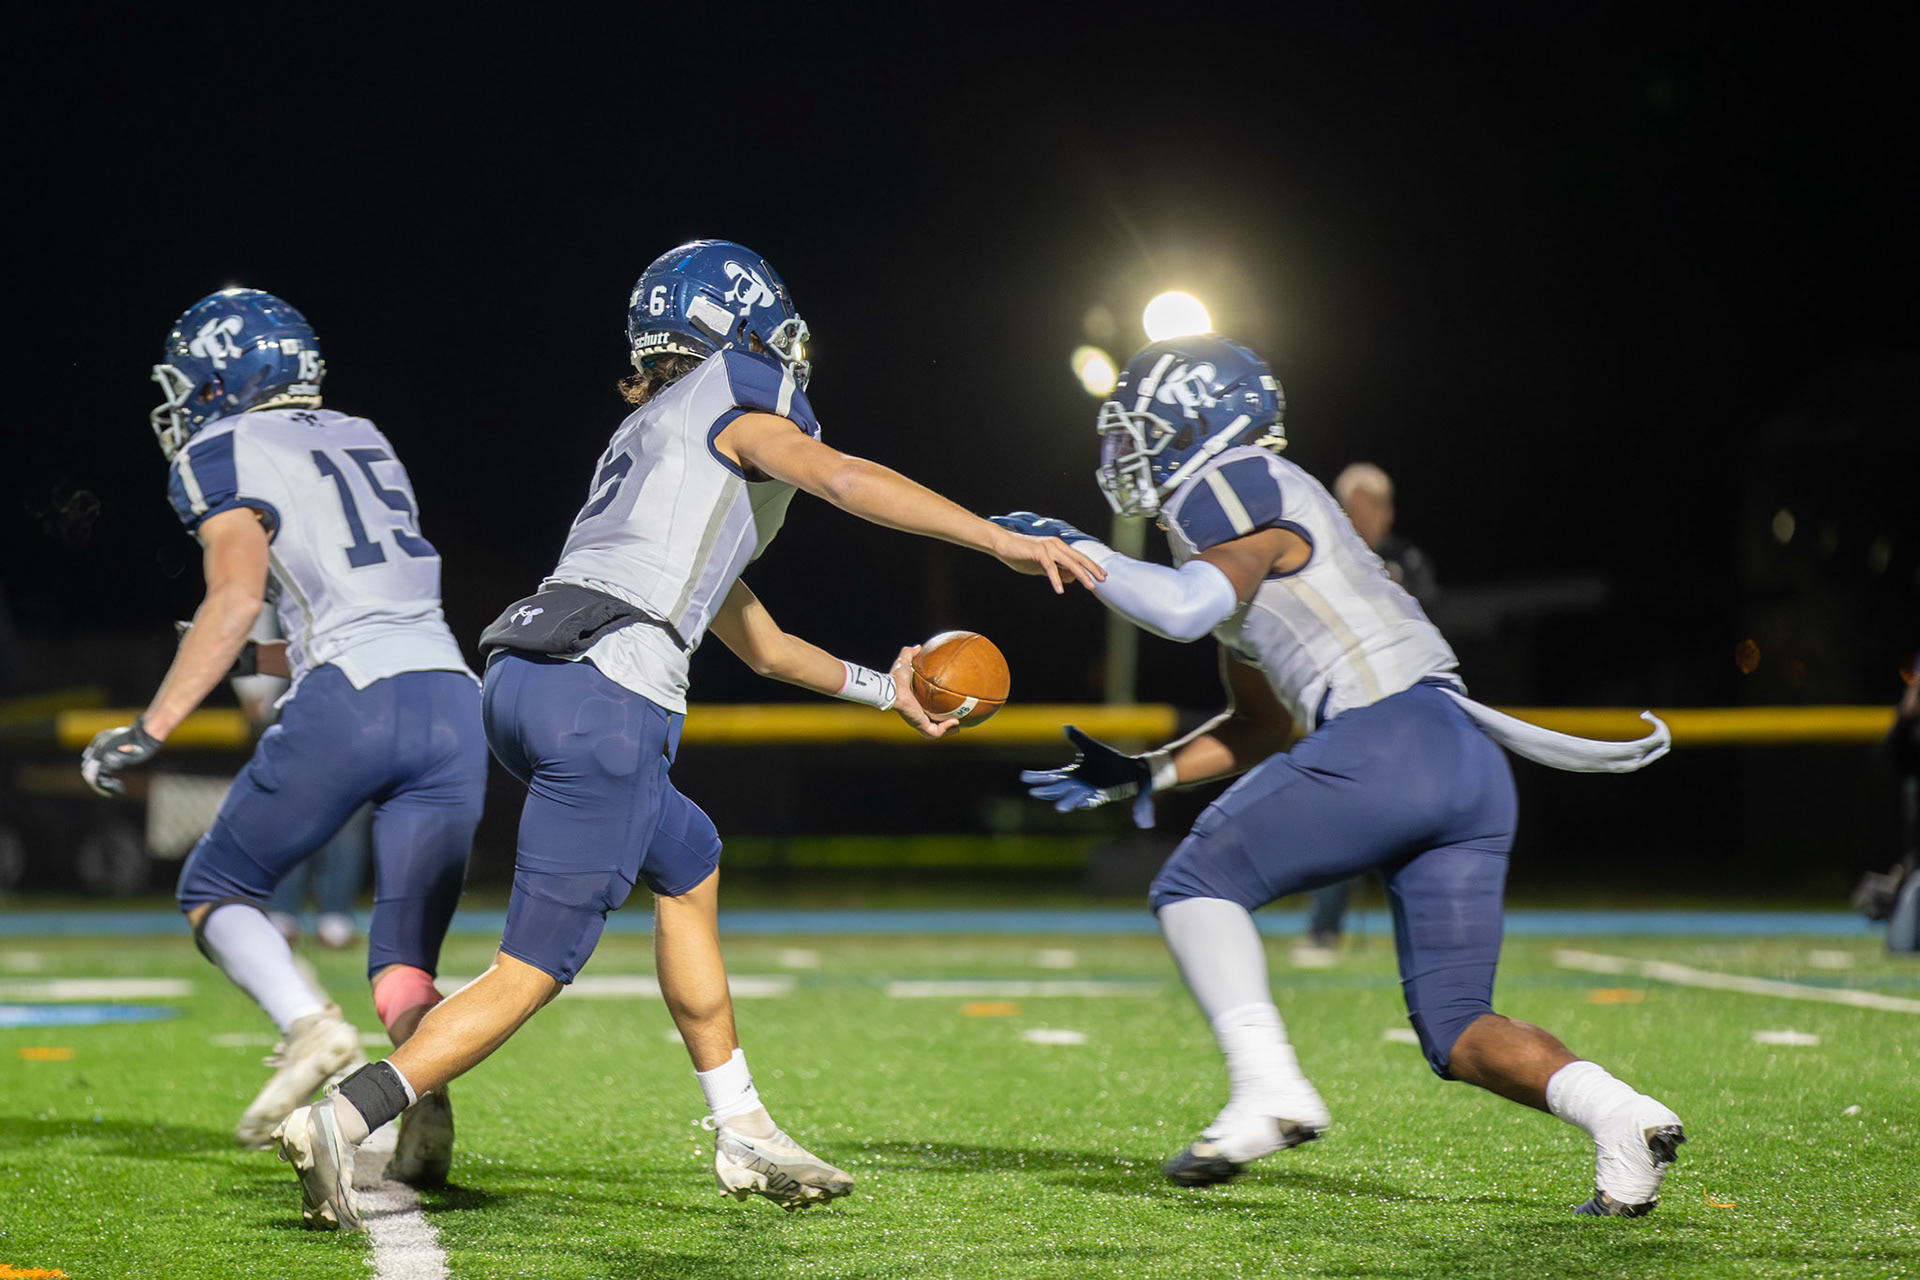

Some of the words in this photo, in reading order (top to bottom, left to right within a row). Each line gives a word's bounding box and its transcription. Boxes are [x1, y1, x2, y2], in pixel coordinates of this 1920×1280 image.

[650, 285, 667, 316] 6
[297, 350, 320, 380] 15
[309, 448, 441, 569] 15
